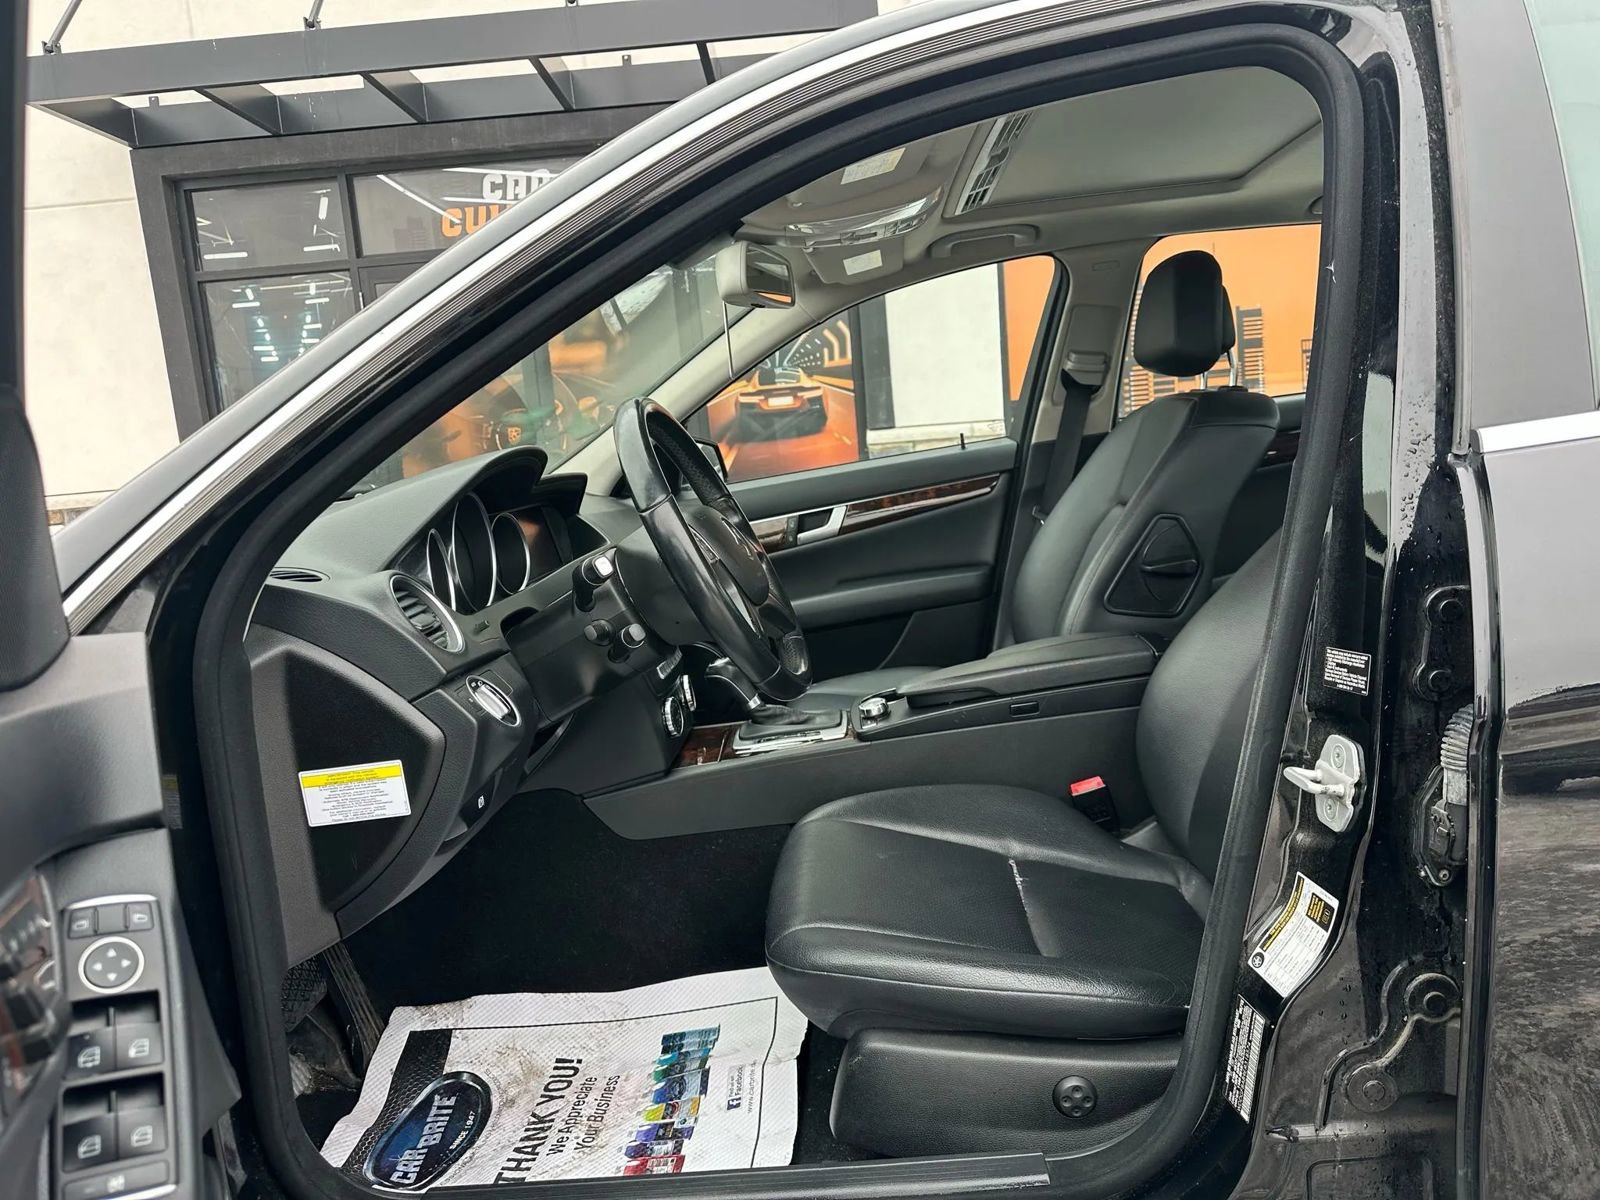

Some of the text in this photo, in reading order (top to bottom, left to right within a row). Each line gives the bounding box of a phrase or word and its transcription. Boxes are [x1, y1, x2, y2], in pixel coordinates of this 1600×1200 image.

[449, 1130, 469, 1150] SINCE
[464, 1111, 476, 1129] 1947
[492, 1057, 583, 1184] THANK YOU!
[546, 1076, 598, 1156] We Appreciate
[574, 1075, 621, 1151] Your Business
